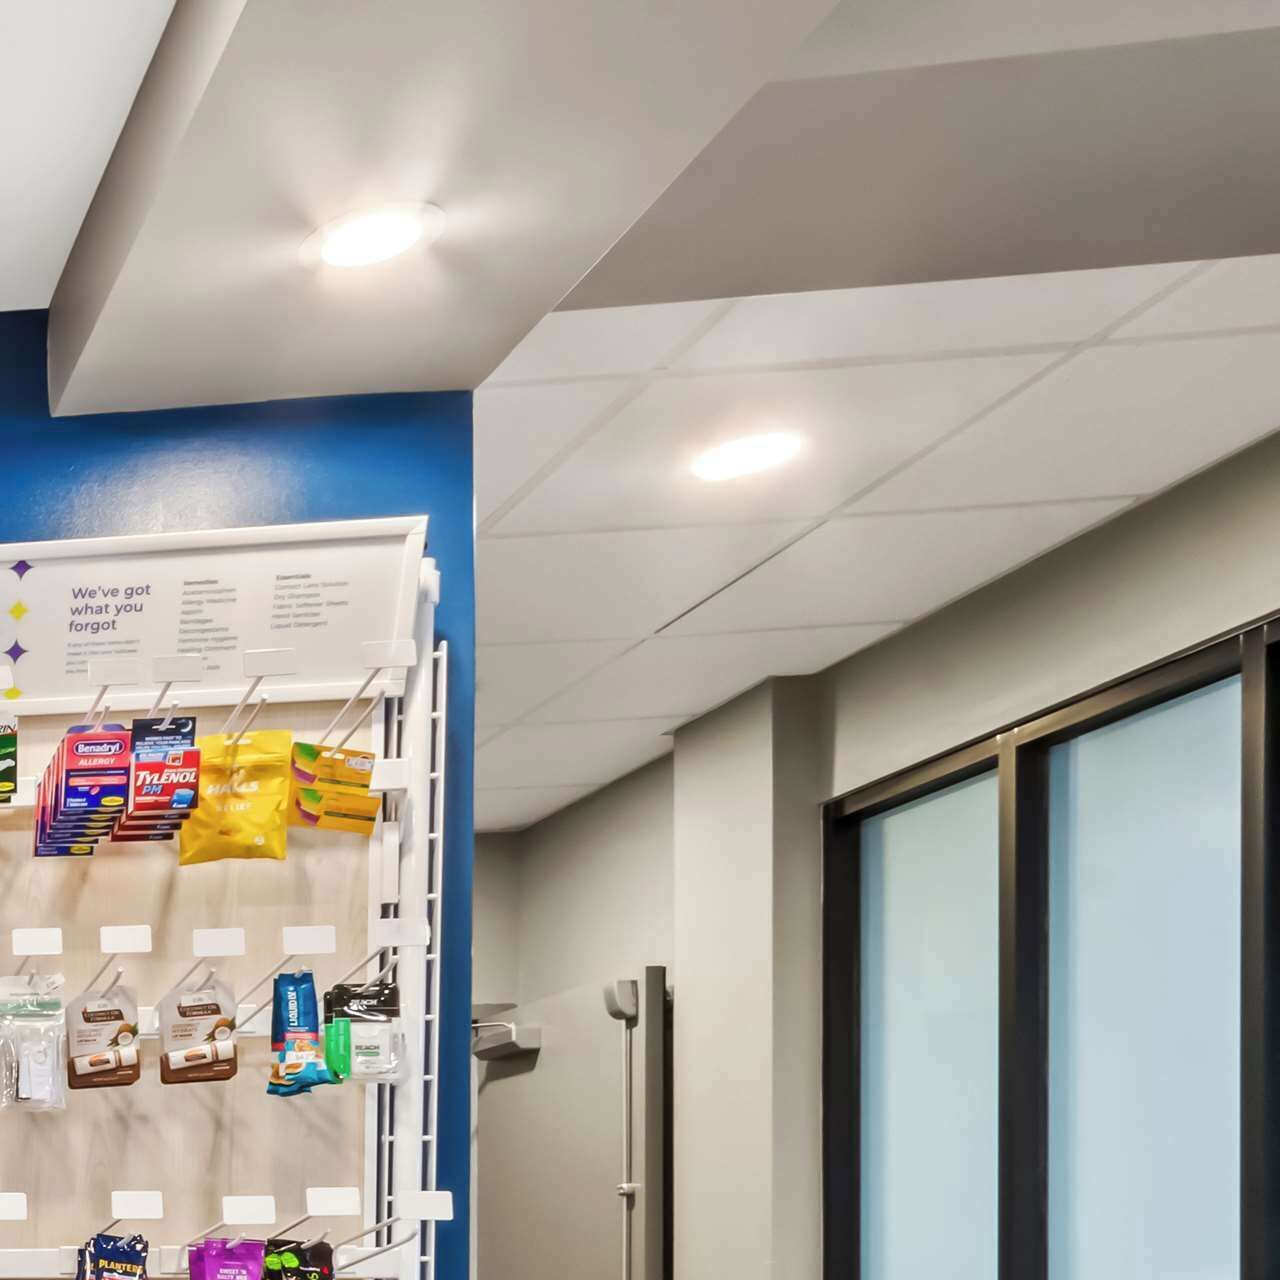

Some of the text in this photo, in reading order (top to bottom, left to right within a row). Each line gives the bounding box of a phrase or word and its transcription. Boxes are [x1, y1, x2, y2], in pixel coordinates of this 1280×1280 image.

[71, 583, 151, 603] We've got
[70, 602, 144, 620] what you
[68, 619, 117, 634] forgot
[77, 742, 120, 754] Benadryl
[78, 758, 116, 766] ALLERGY
[135, 770, 197, 787] TYLENOL
[141, 785, 163, 795] PM
[98, 1258, 144, 1274] PLANTERS
